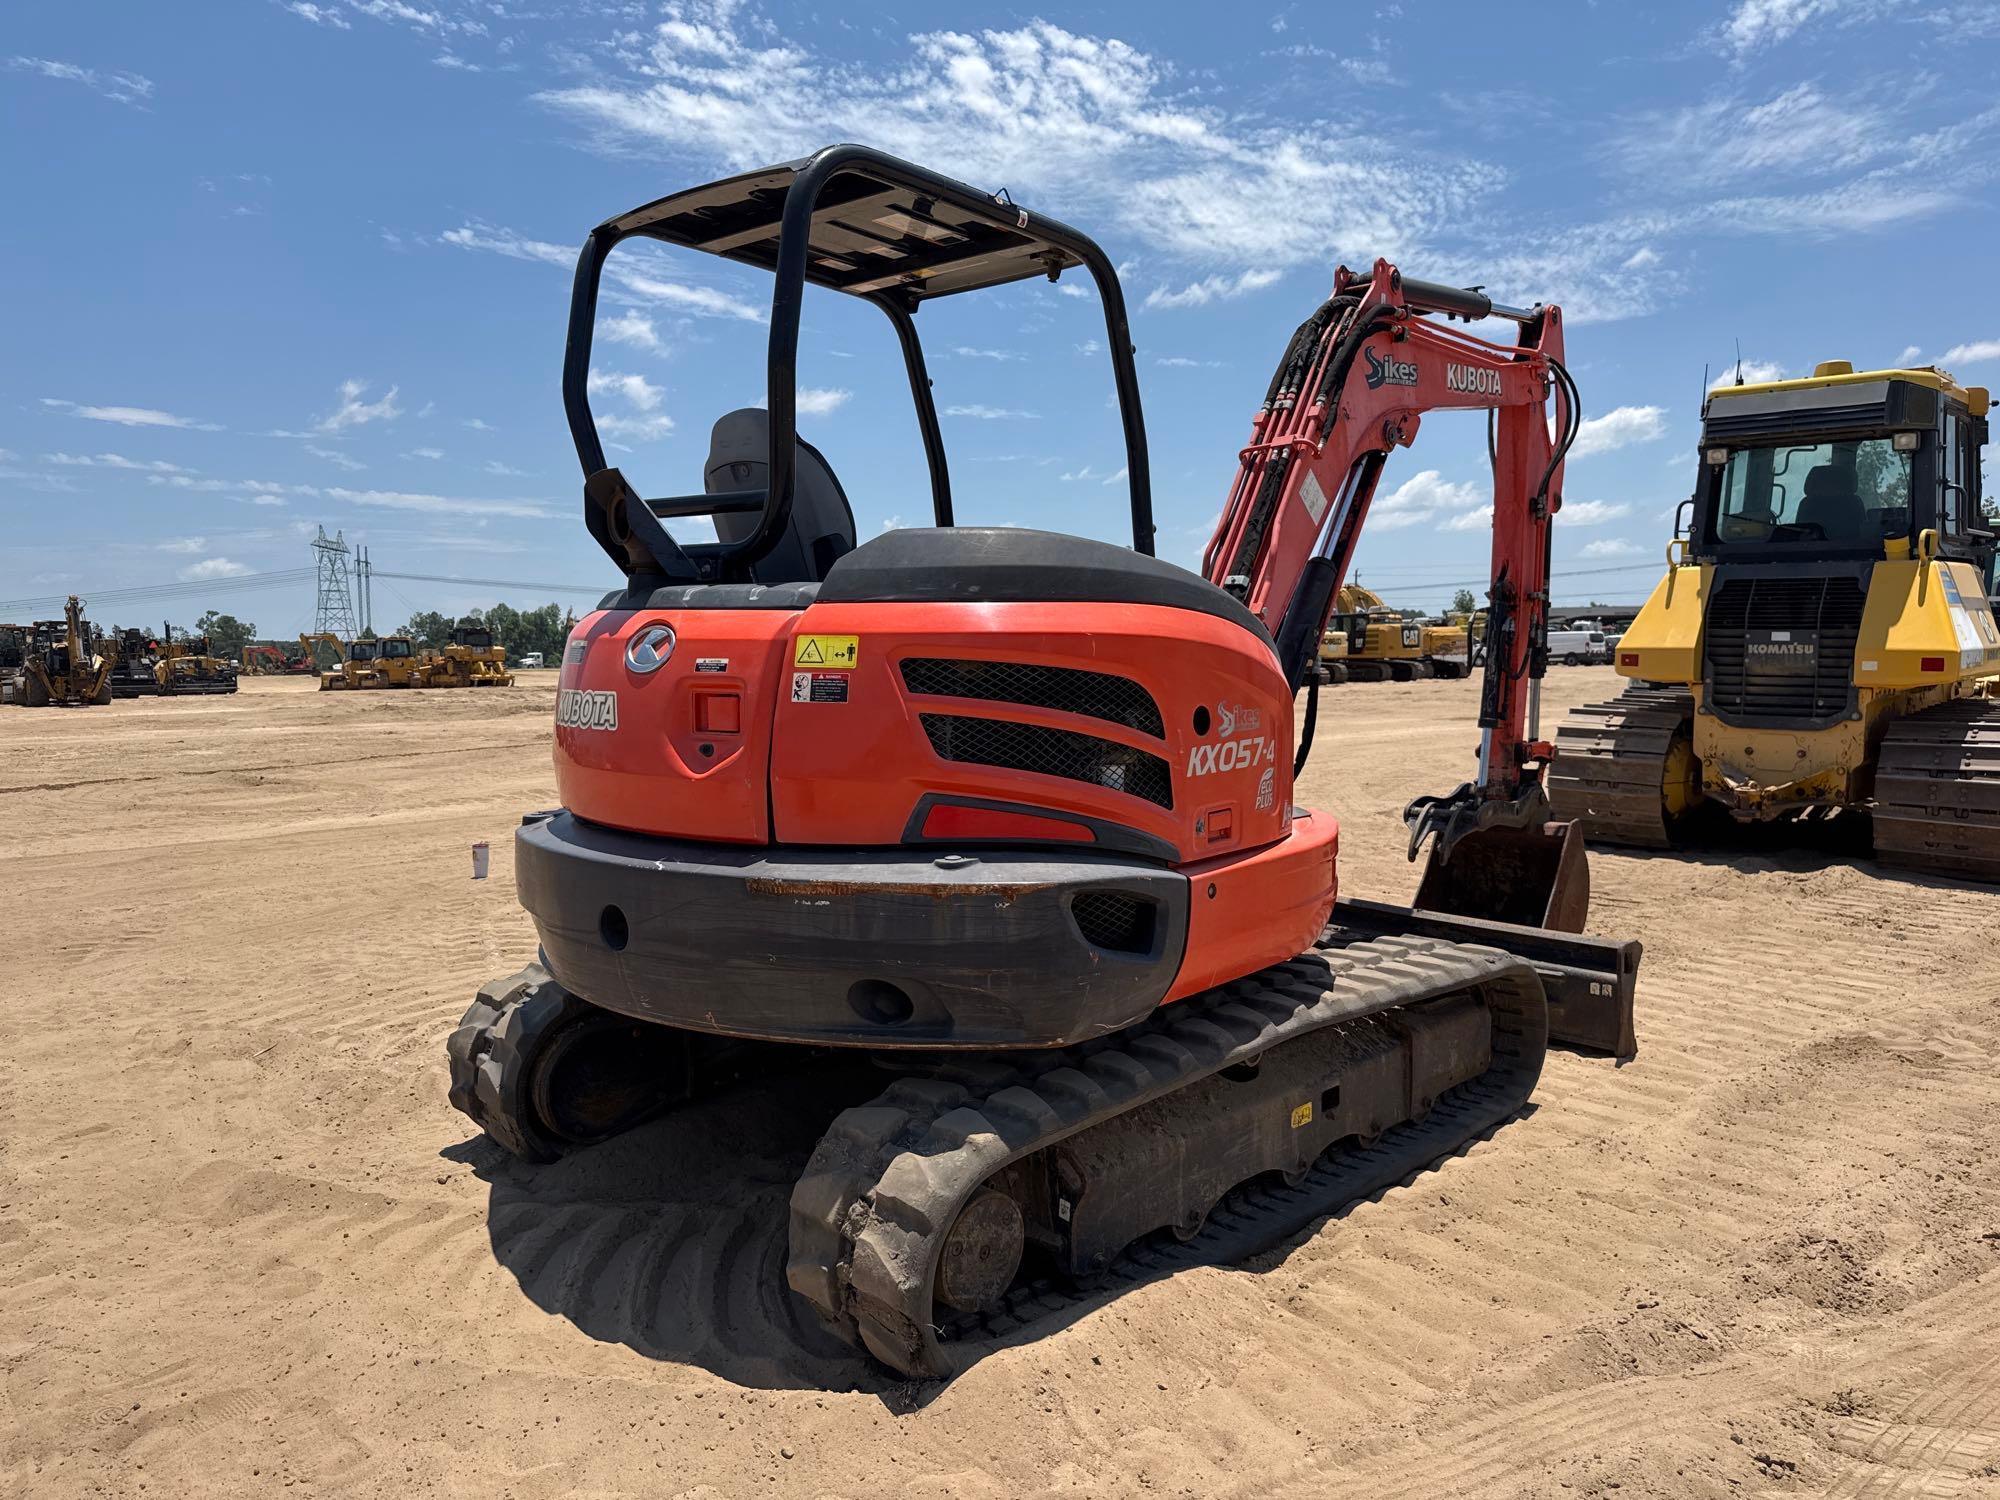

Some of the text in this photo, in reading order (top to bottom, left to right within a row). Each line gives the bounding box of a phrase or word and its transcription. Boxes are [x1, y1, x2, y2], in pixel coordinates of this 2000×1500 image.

[1365, 346, 1418, 389] Sikes
[1448, 363, 1502, 396] KUBOTA
[1403, 630, 1418, 646] CAT
[1747, 642, 1814, 654] KOMATSU
[557, 690, 616, 728] KUBOTA
[1255, 794, 1273, 810] PLUS
